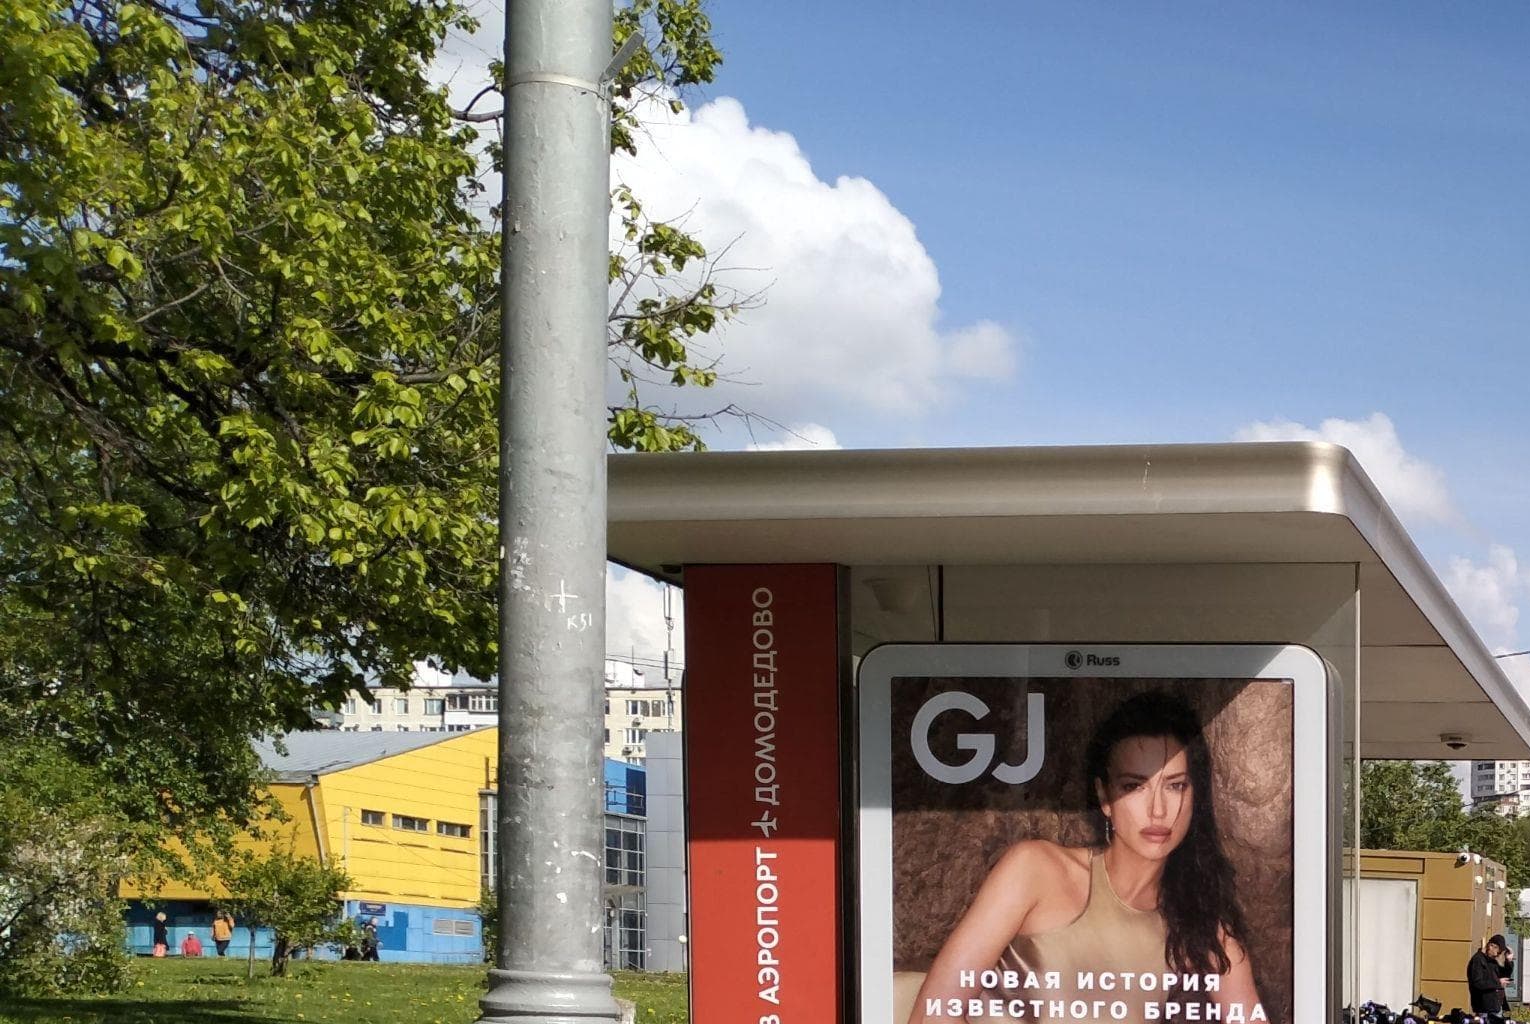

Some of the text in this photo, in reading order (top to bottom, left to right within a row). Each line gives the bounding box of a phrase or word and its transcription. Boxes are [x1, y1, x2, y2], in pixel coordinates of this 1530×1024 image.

[1086, 654, 1121, 667] Russ
[751, 587, 780, 806] ДОМОДЕДОВО
[910, 690, 1045, 785] GJ
[755, 846, 780, 1005] АЭРОПОРТ
[925, 998, 1268, 1024] ИЗВЕСТНОГО БРЕНДА
[959, 969, 1221, 993] НОВАЯ ИСТОРИЯ
